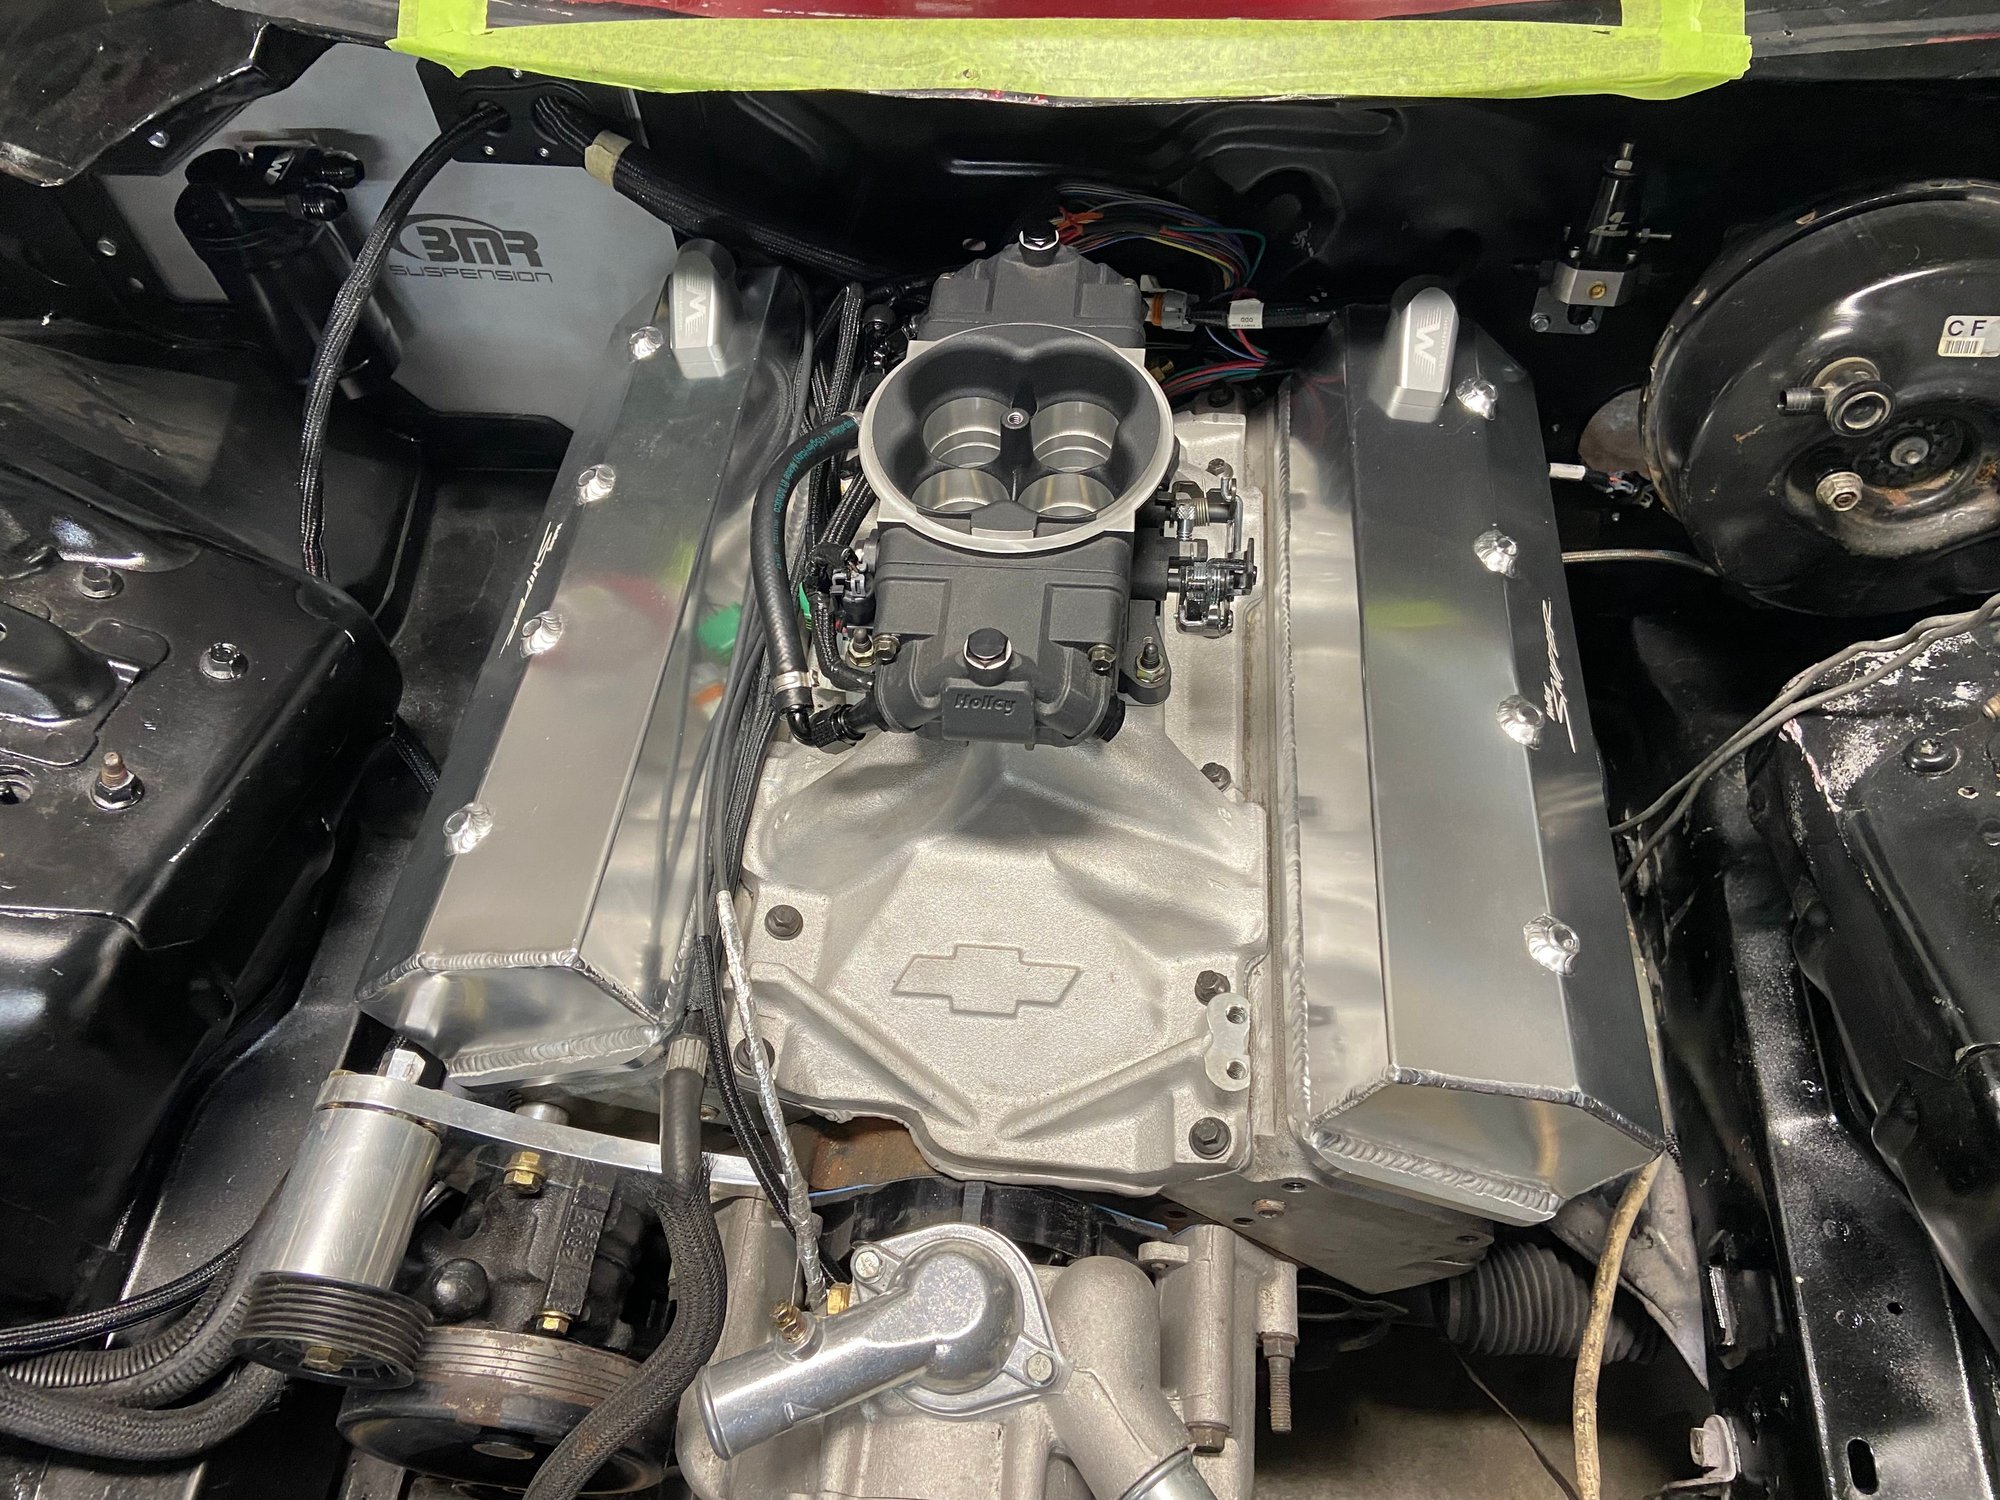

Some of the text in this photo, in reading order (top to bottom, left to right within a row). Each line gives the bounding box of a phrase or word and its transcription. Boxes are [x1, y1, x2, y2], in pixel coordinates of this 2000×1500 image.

[416, 226, 544, 268] BMR
[389, 264, 554, 284] SUSPENSION
[954, 693, 1017, 716] Holley
